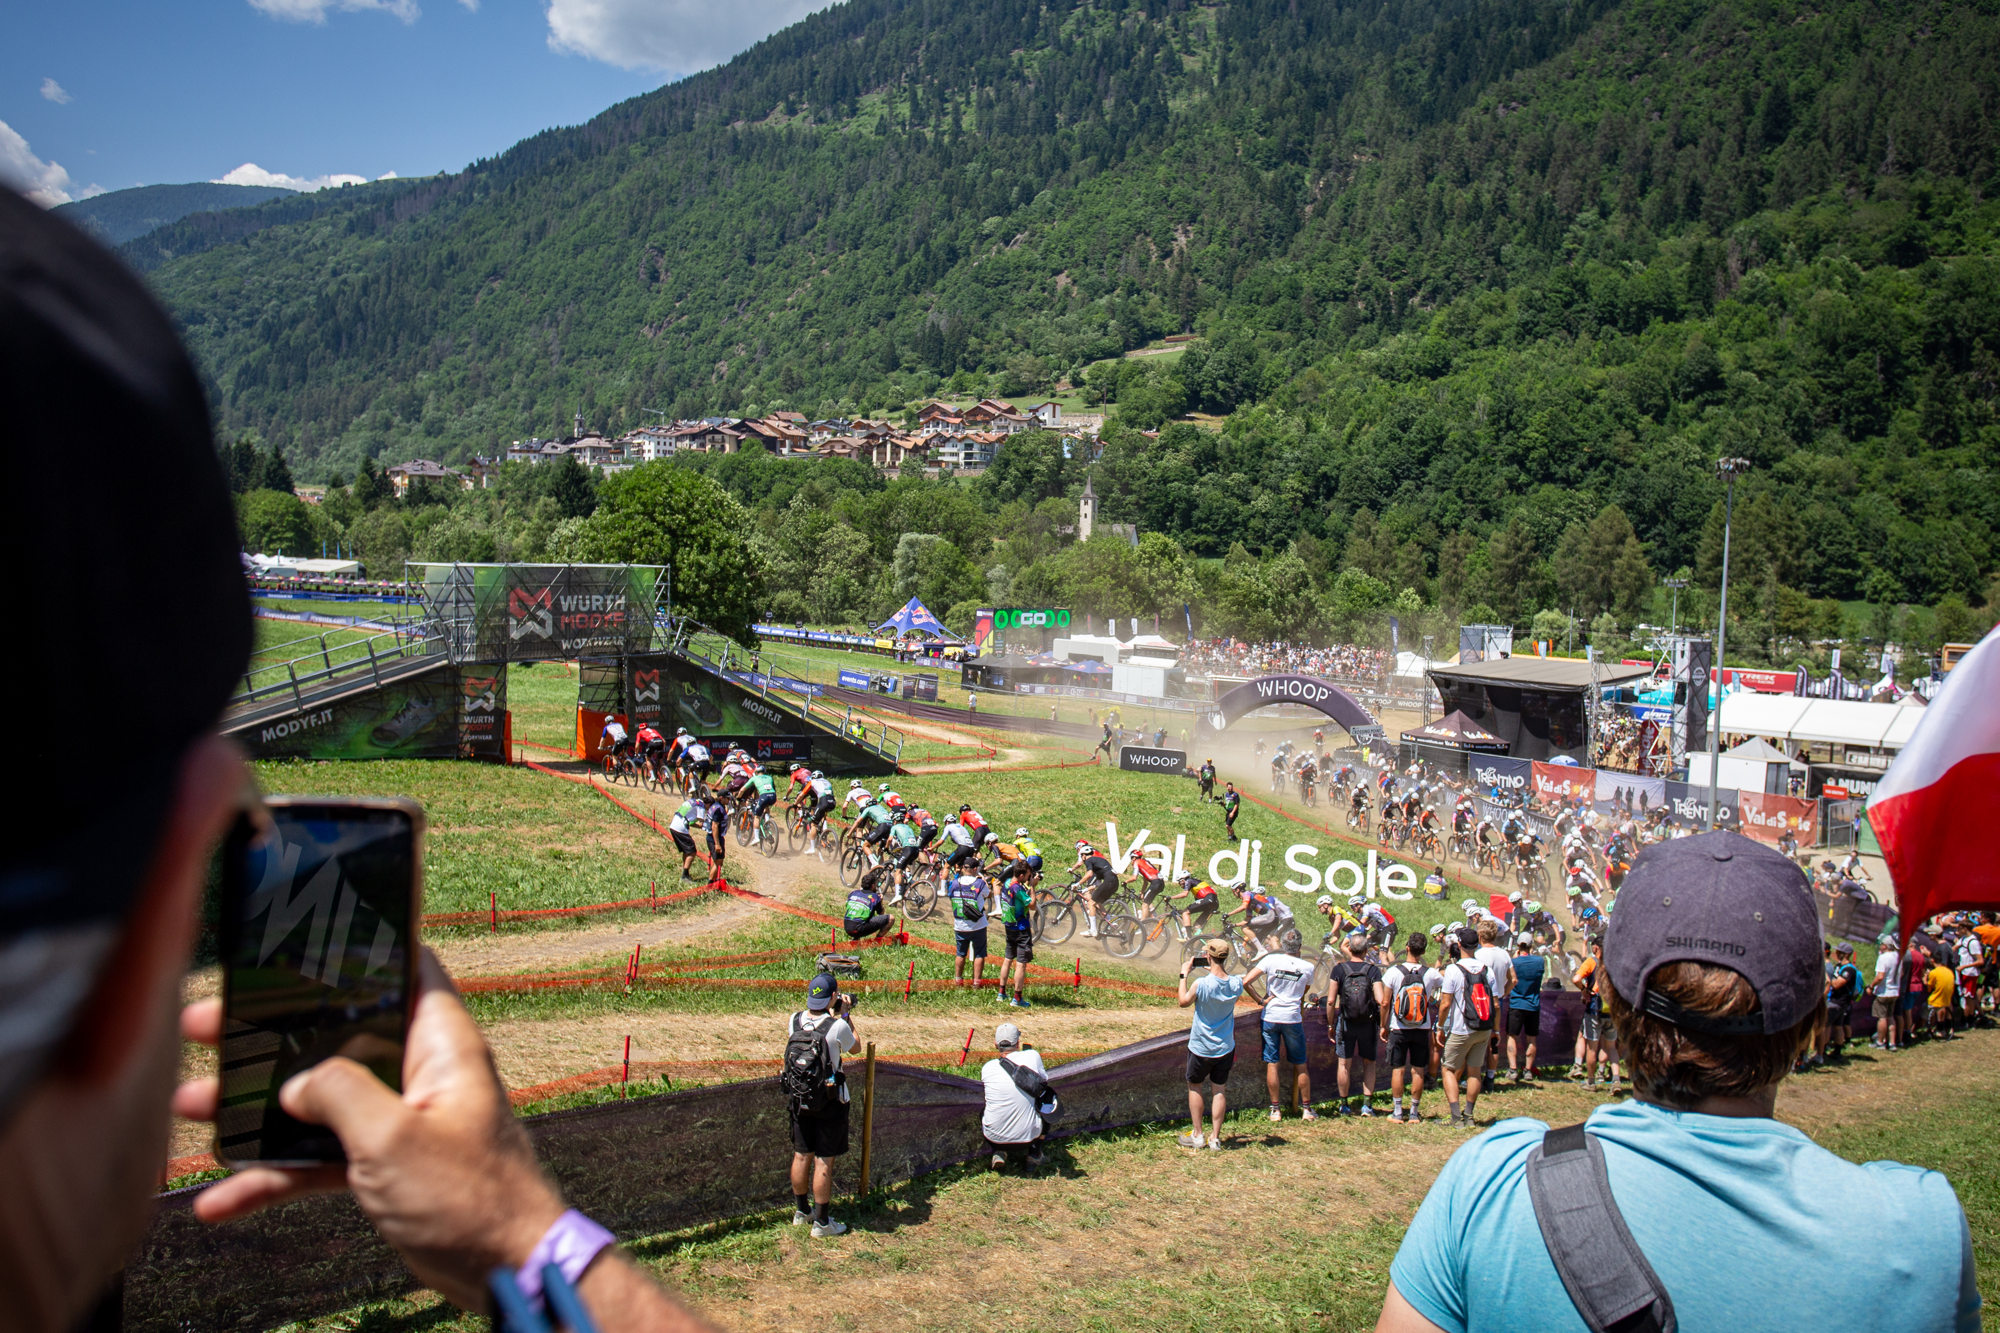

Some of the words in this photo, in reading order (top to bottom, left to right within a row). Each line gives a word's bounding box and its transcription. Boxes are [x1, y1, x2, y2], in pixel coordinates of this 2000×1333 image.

[1256, 679, 1331, 702] WHOOP
[741, 698, 782, 724] MODYF.IT
[262, 708, 334, 744] MODYF.IT
[1129, 754, 1181, 768] WHOOP
[1475, 767, 1525, 789] TRENTINO
[1535, 774, 1554, 793] Val
[1553, 785, 1562, 794] di
[1483, 803, 1513, 823] WHOO
[1673, 797, 1731, 822] TRENTO
[1743, 805, 1766, 826] Val
[1766, 815, 1777, 827] di
[1106, 821, 1186, 883] Val
[1208, 839, 1263, 888] di
[1284, 844, 1417, 900] Sole
[1666, 936, 1747, 957] SHIMANO
